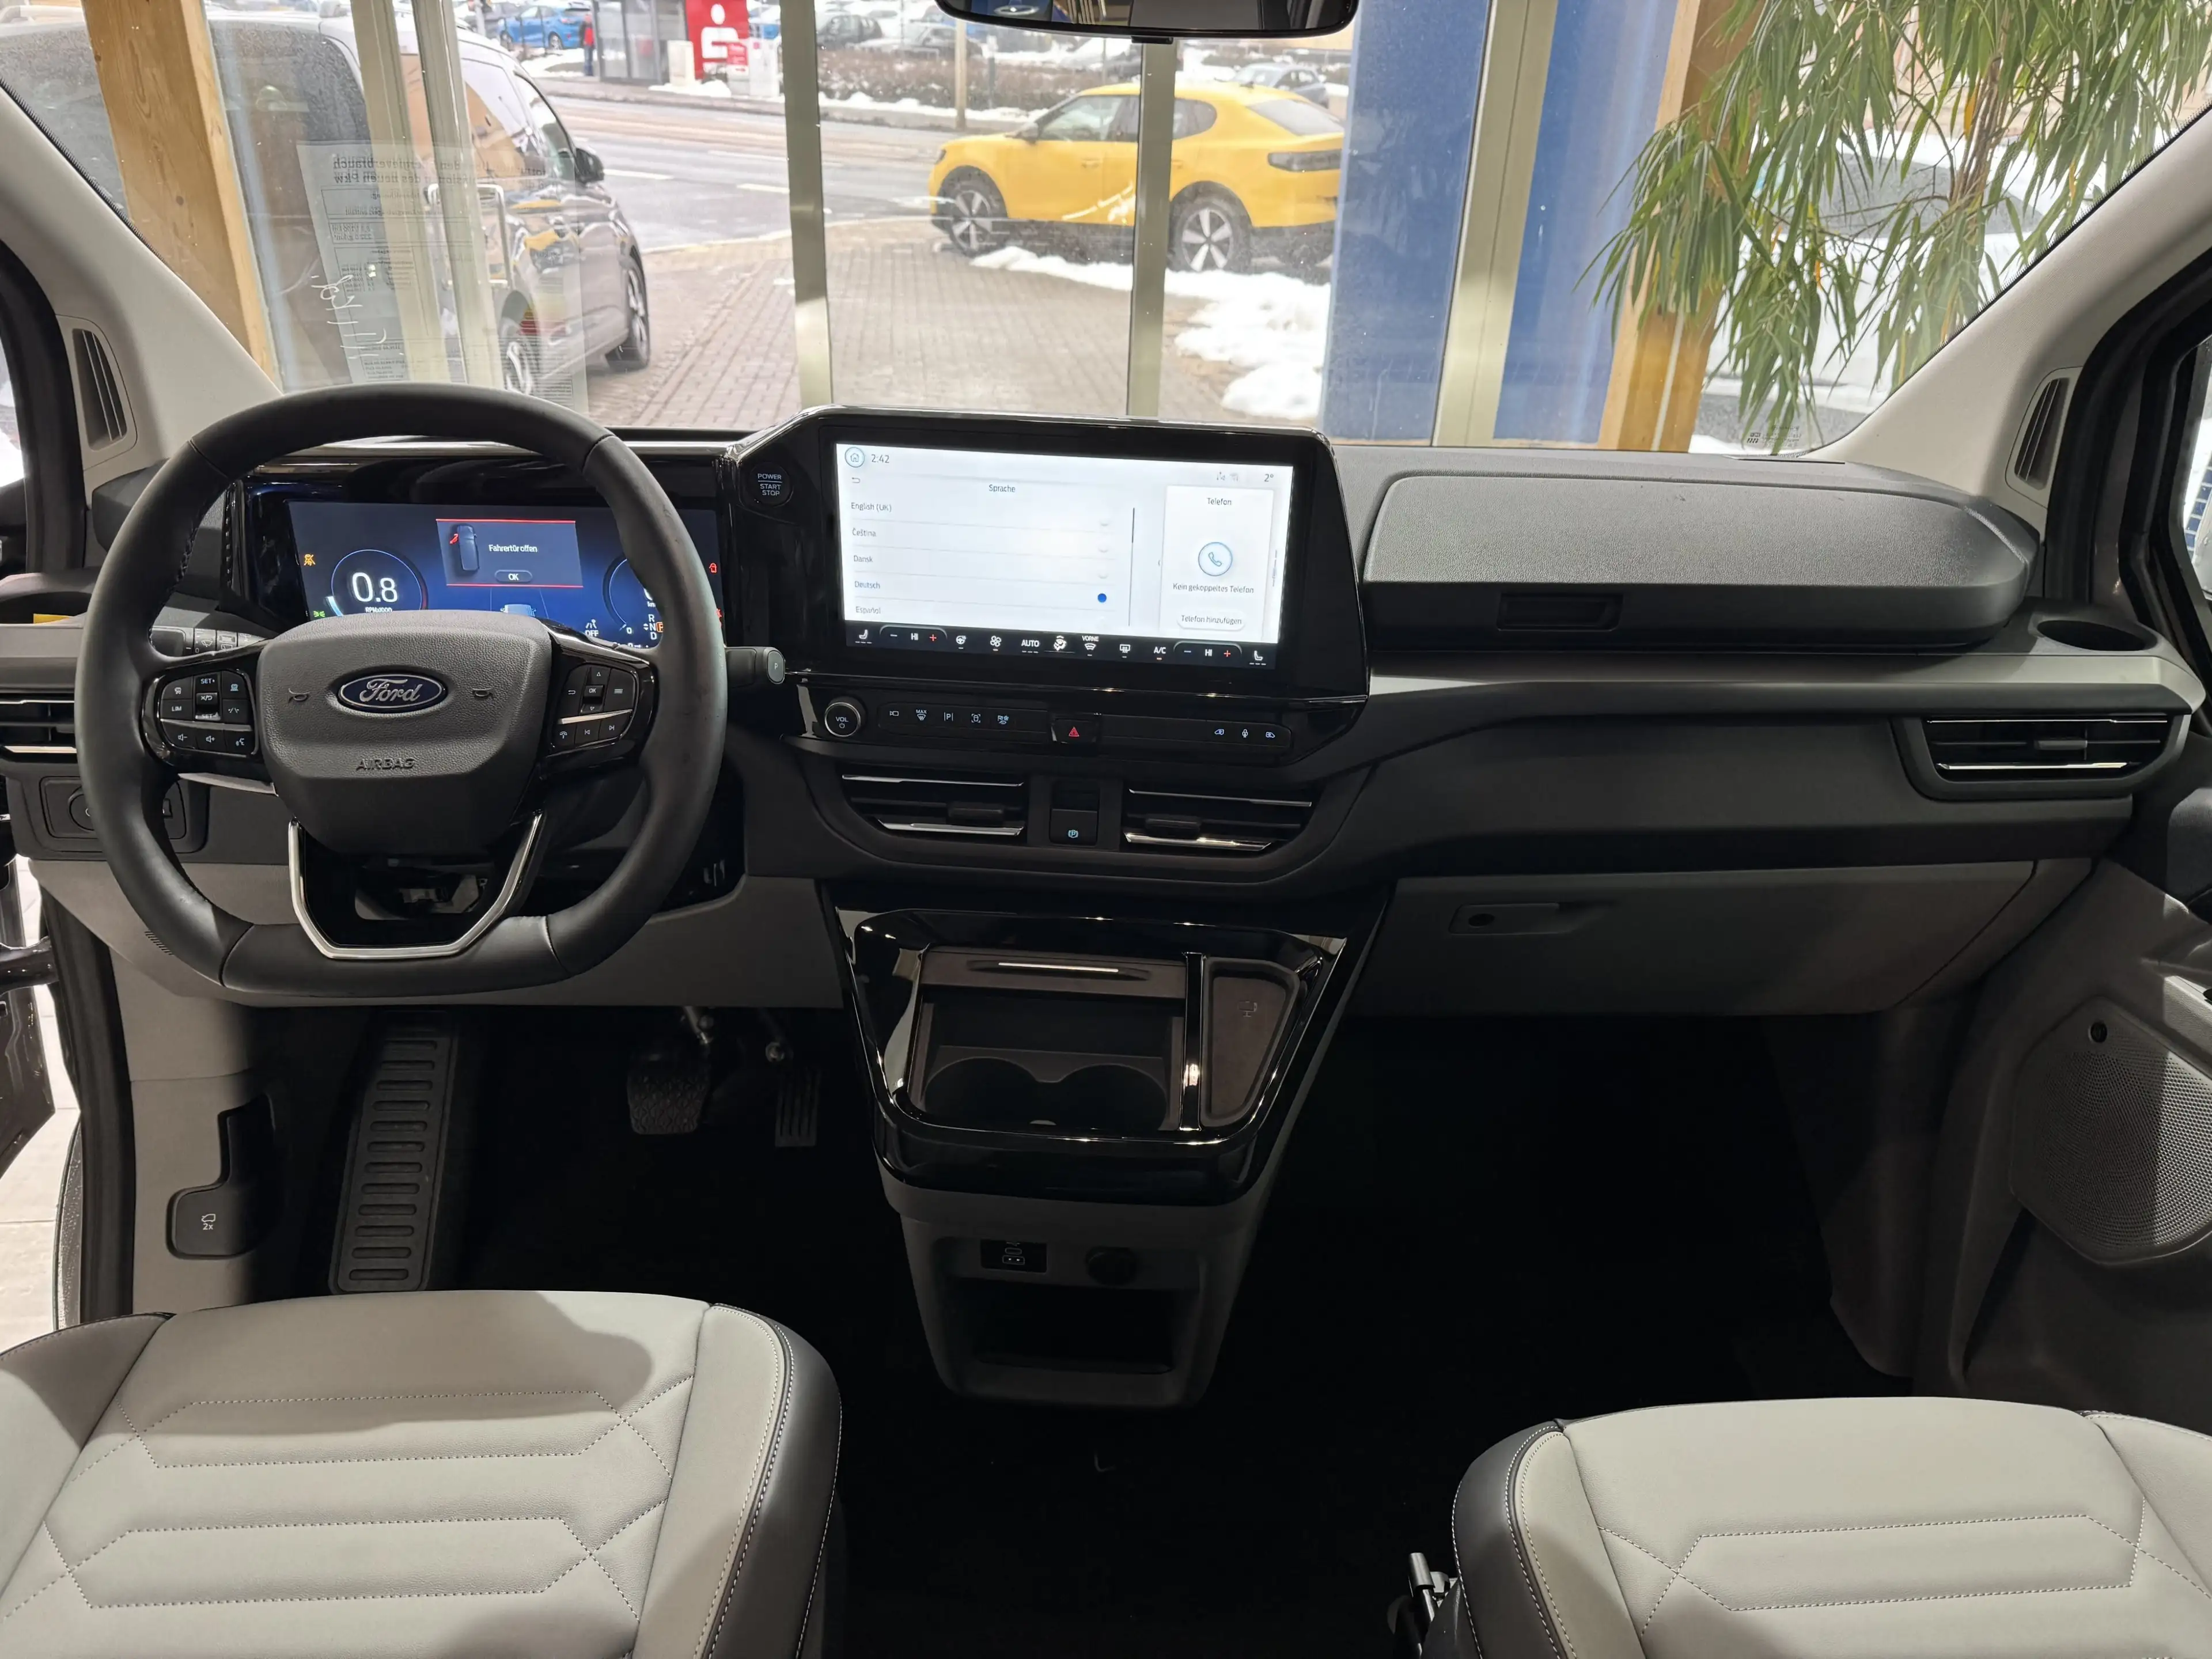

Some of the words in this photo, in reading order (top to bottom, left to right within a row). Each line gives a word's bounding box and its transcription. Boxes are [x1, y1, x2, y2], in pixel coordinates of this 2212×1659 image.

[871, 454, 890, 464] 2:42
[988, 484, 1016, 493] Sprache
[851, 502, 874, 511] English
[876, 503, 892, 512] (UK)
[852, 527, 877, 537] Čeština
[853, 555, 873, 563] Dansk
[352, 572, 397, 603] 0.8
[854, 581, 881, 589] Deutsch
[1188, 584, 1228, 593] gekoppeltes
[1230, 585, 1254, 593] Telefon
[855, 606, 881, 614] Español
[648, 614, 655, 622] R
[1206, 616, 1242, 625] hinzufügen
[649, 623, 656, 631] N
[650, 632, 657, 640] D
[1021, 639, 1040, 647] AUTO
[1205, 649, 1213, 657] HI
[359, 678, 423, 702] Ford
[356, 757, 415, 771] AIRBAG
